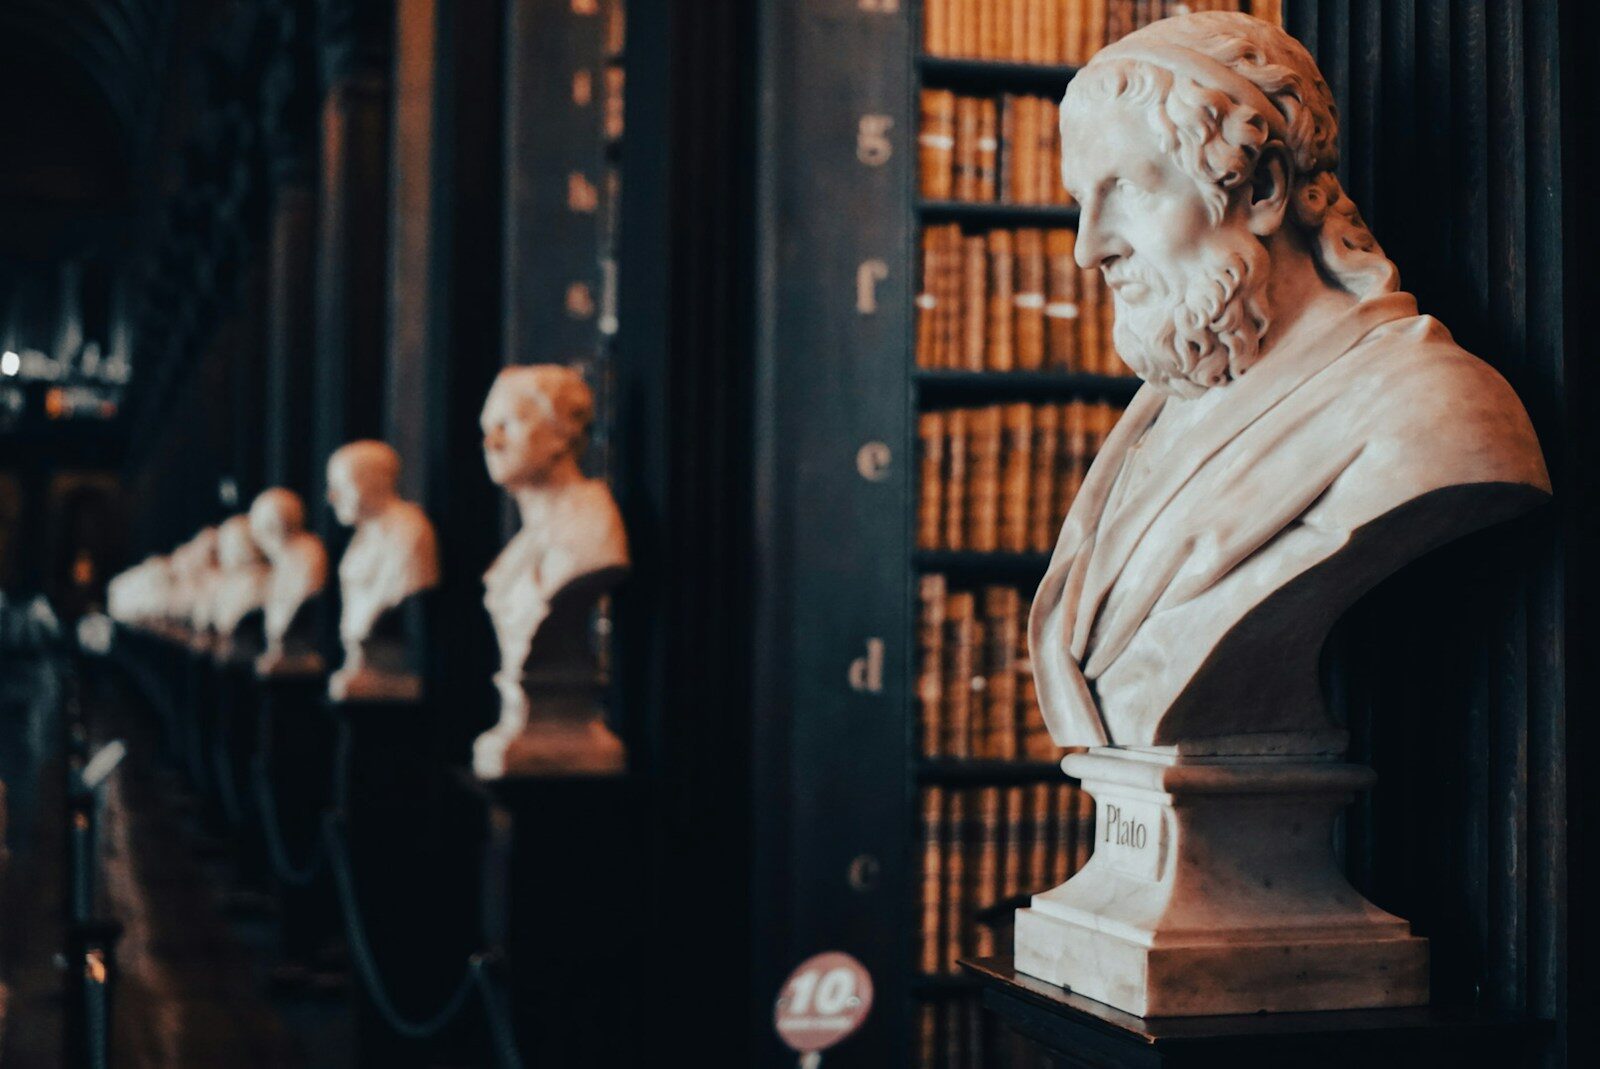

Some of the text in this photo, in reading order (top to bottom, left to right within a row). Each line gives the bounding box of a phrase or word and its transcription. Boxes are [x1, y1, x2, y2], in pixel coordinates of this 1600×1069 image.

[856, 440, 892, 482] e
[848, 636, 885, 691] d
[1105, 804, 1147, 850] Plato
[789, 967, 856, 1015] 10
